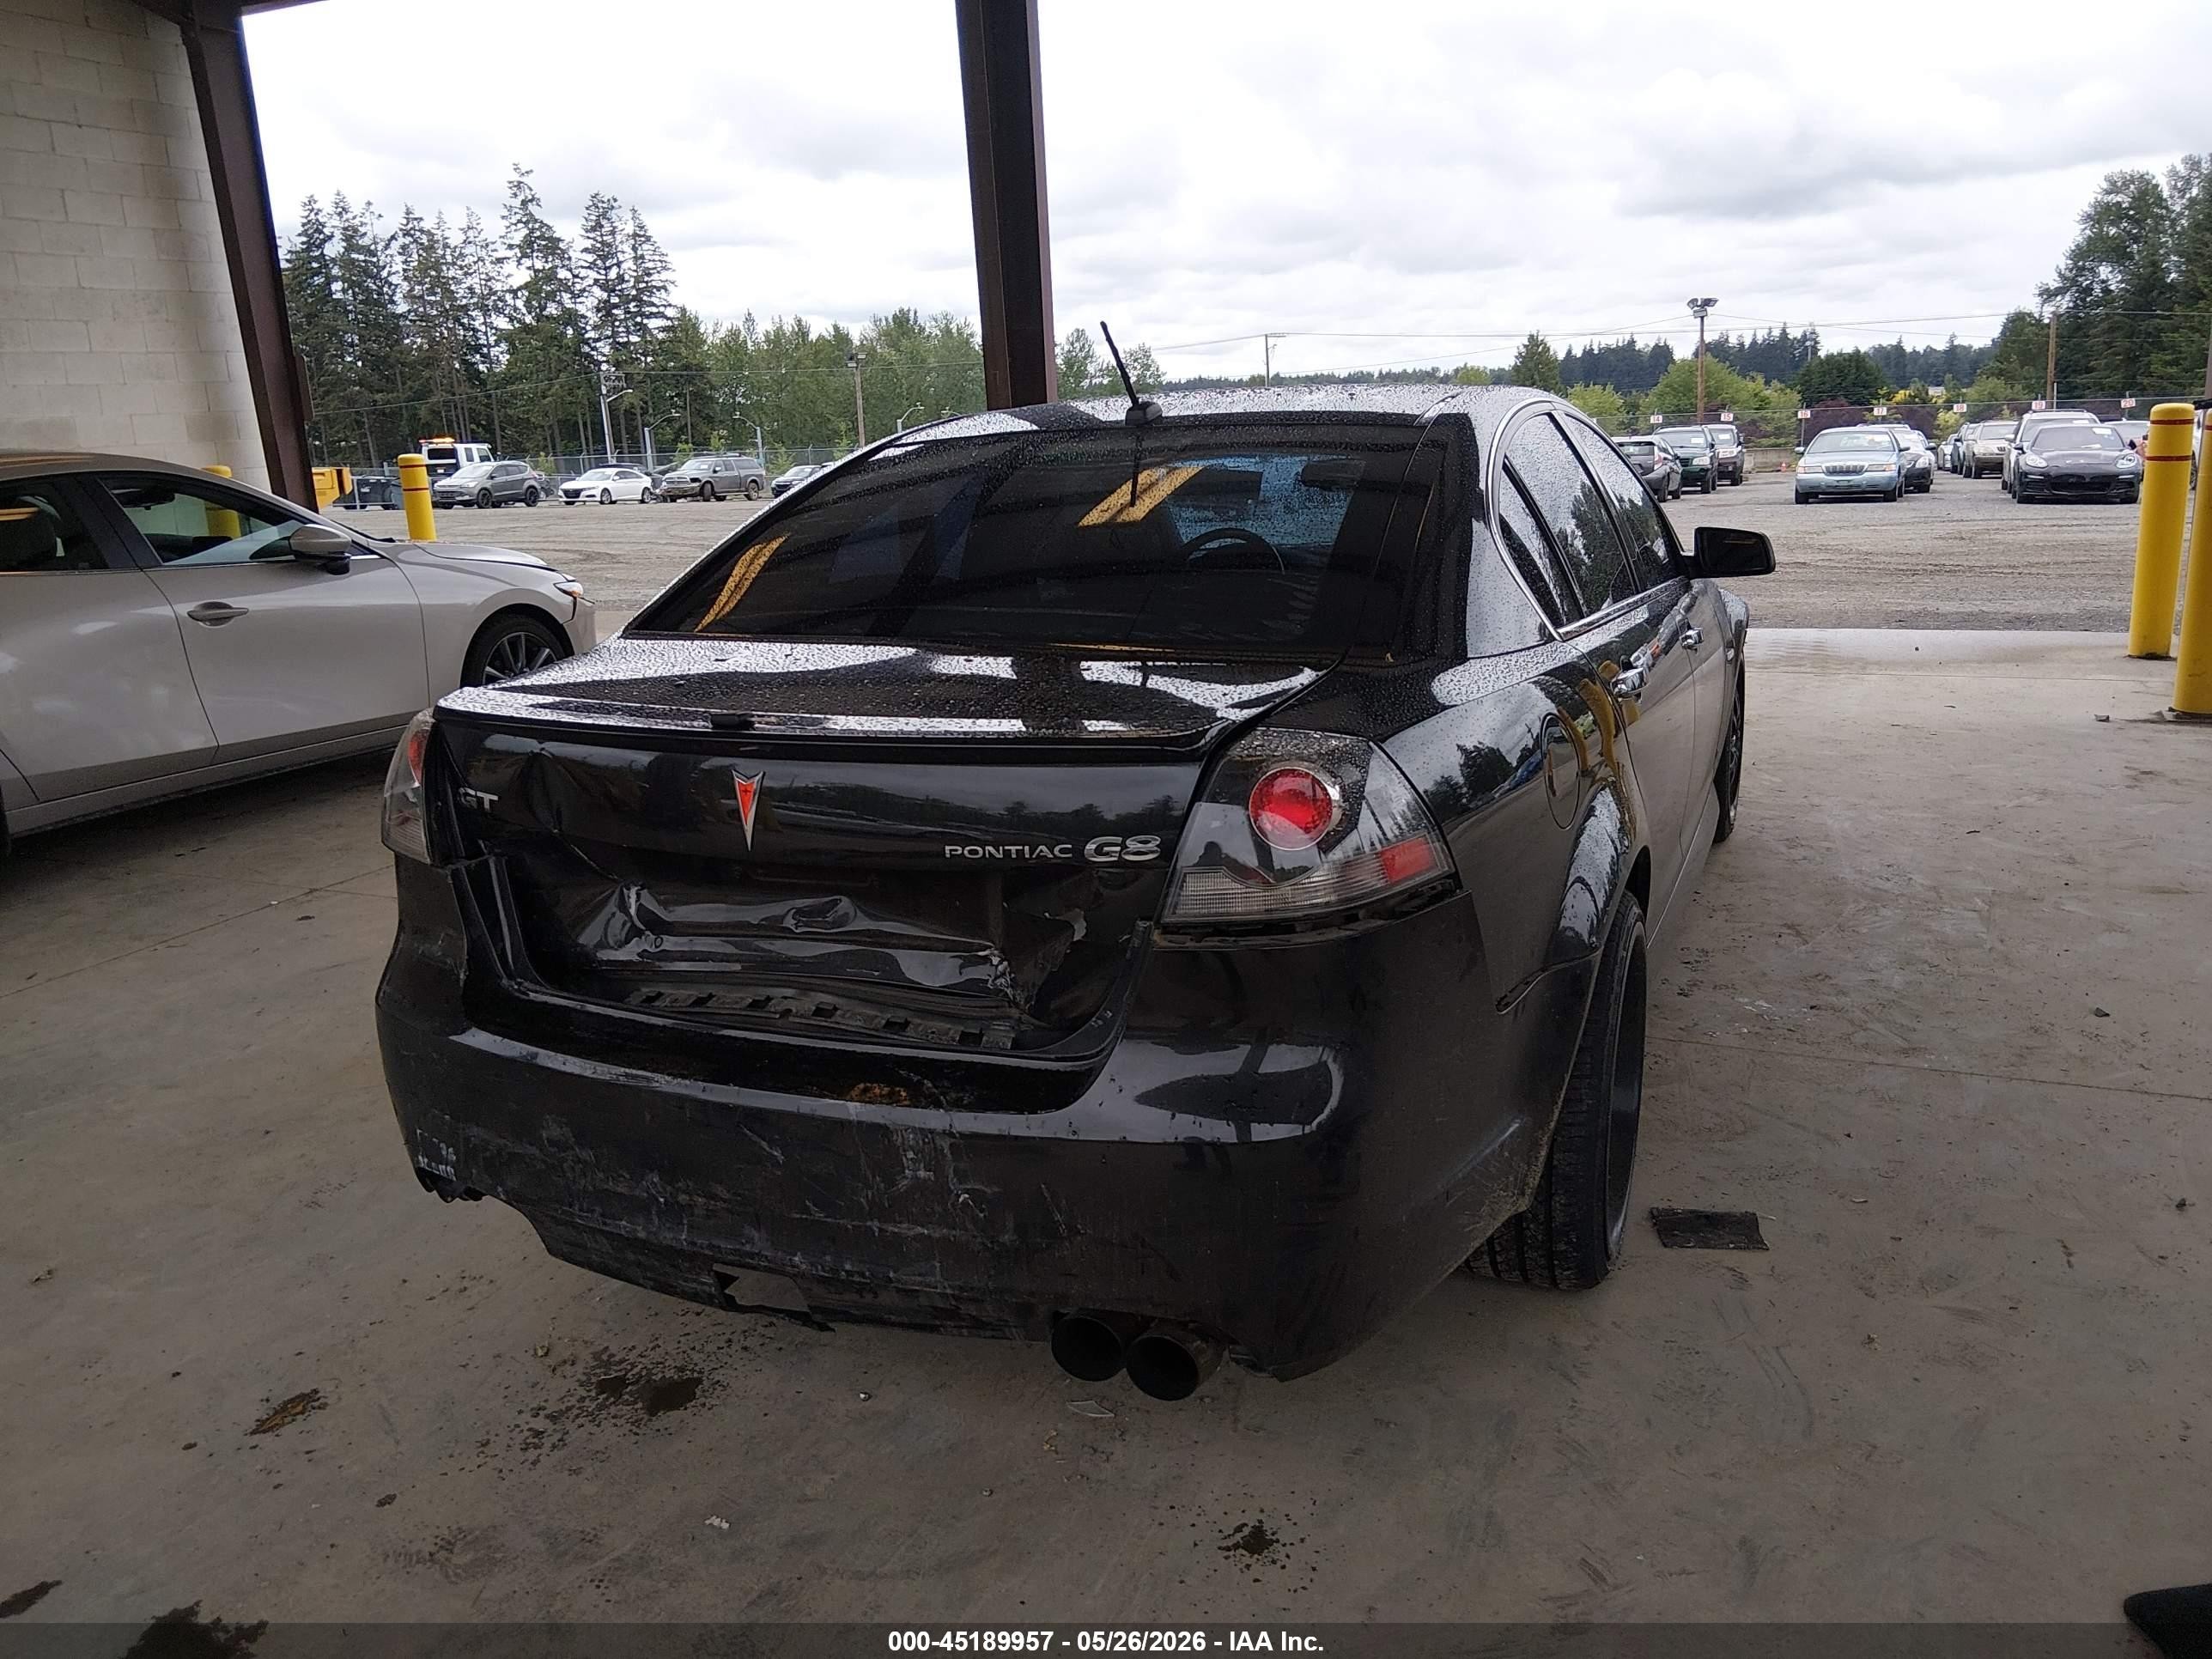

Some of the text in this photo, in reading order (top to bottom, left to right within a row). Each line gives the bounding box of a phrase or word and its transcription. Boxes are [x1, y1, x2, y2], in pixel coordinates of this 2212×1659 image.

[2122, 398, 2135, 408] 20
[459, 787, 499, 811] GT
[945, 835, 1161, 861] PONTIAC G8
